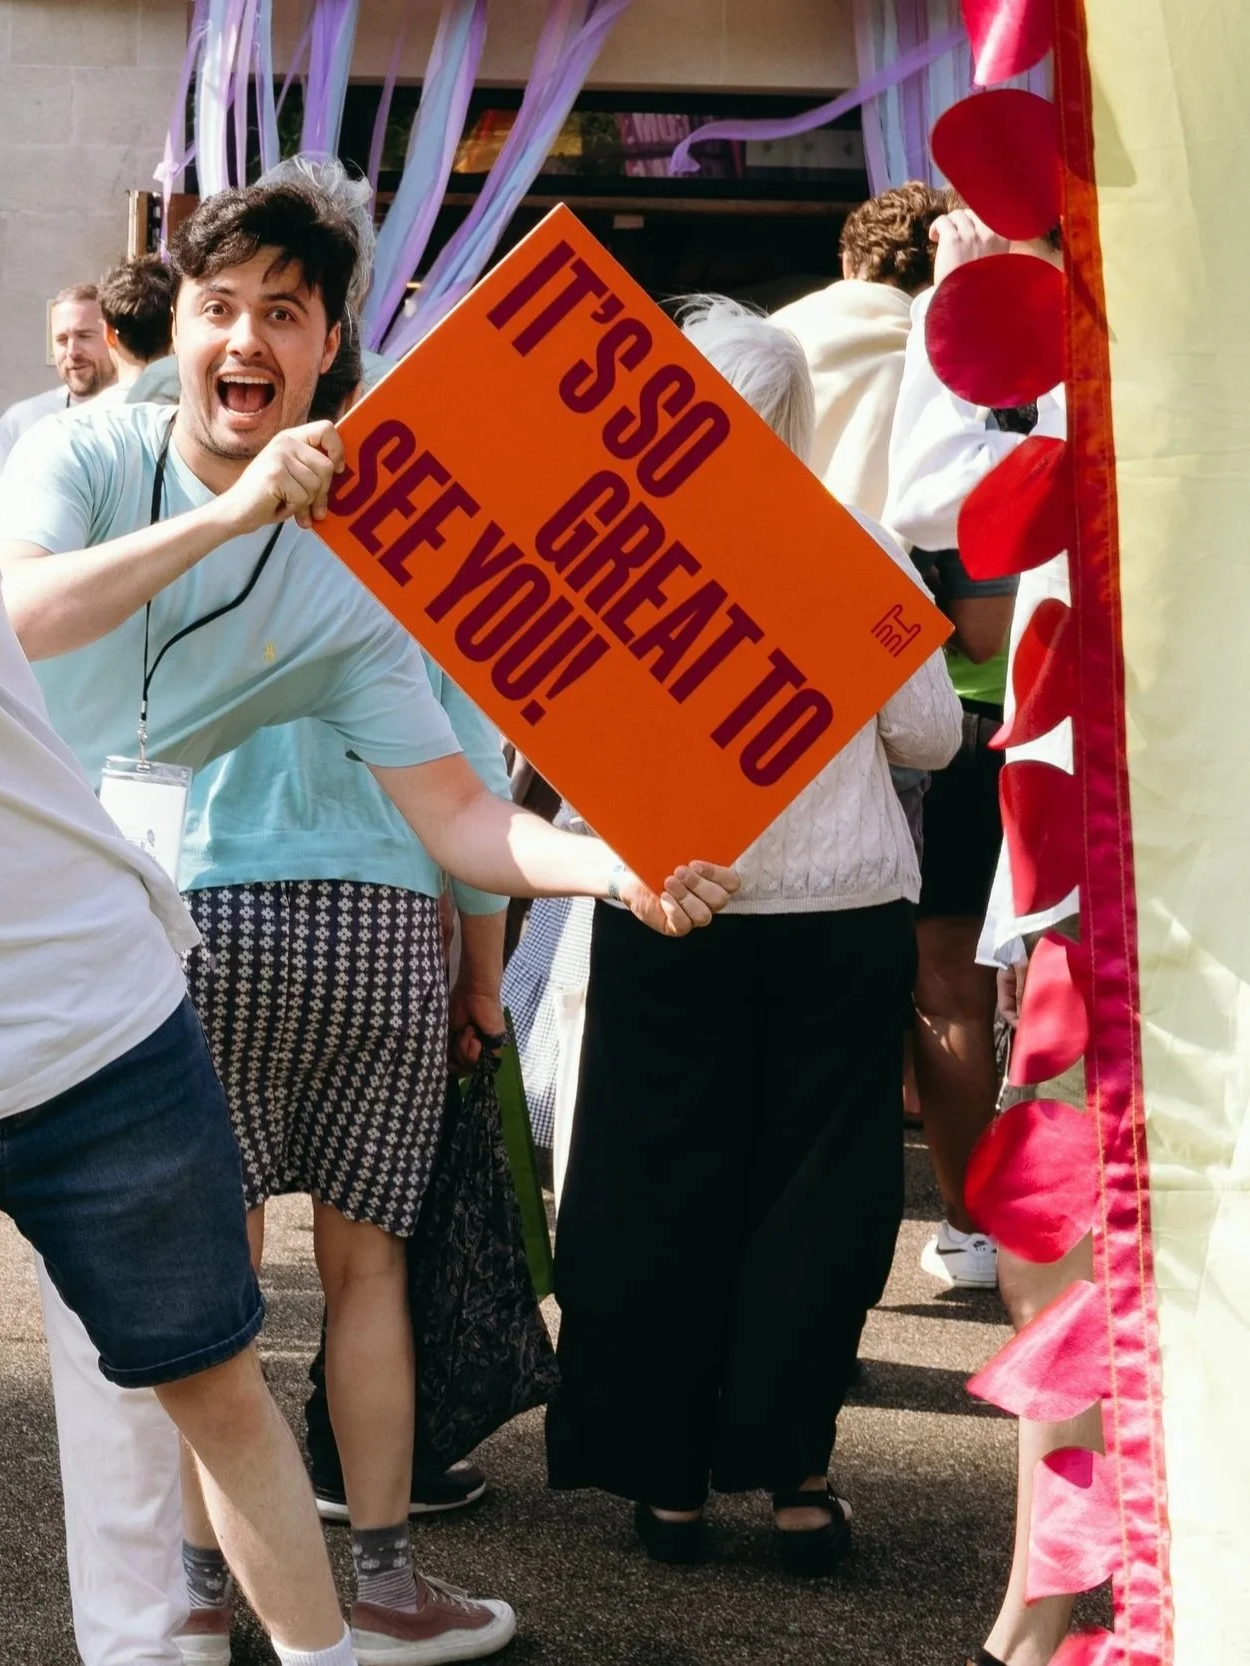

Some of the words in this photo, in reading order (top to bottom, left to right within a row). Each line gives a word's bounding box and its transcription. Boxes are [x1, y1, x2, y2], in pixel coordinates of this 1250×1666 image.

[487, 240, 653, 414] IT'S
[602, 364, 731, 498] SO
[327, 419, 480, 587] SEE
[425, 521, 611, 727] YOU!
[535, 470, 764, 704] GREAT
[711, 648, 834, 787] TO
